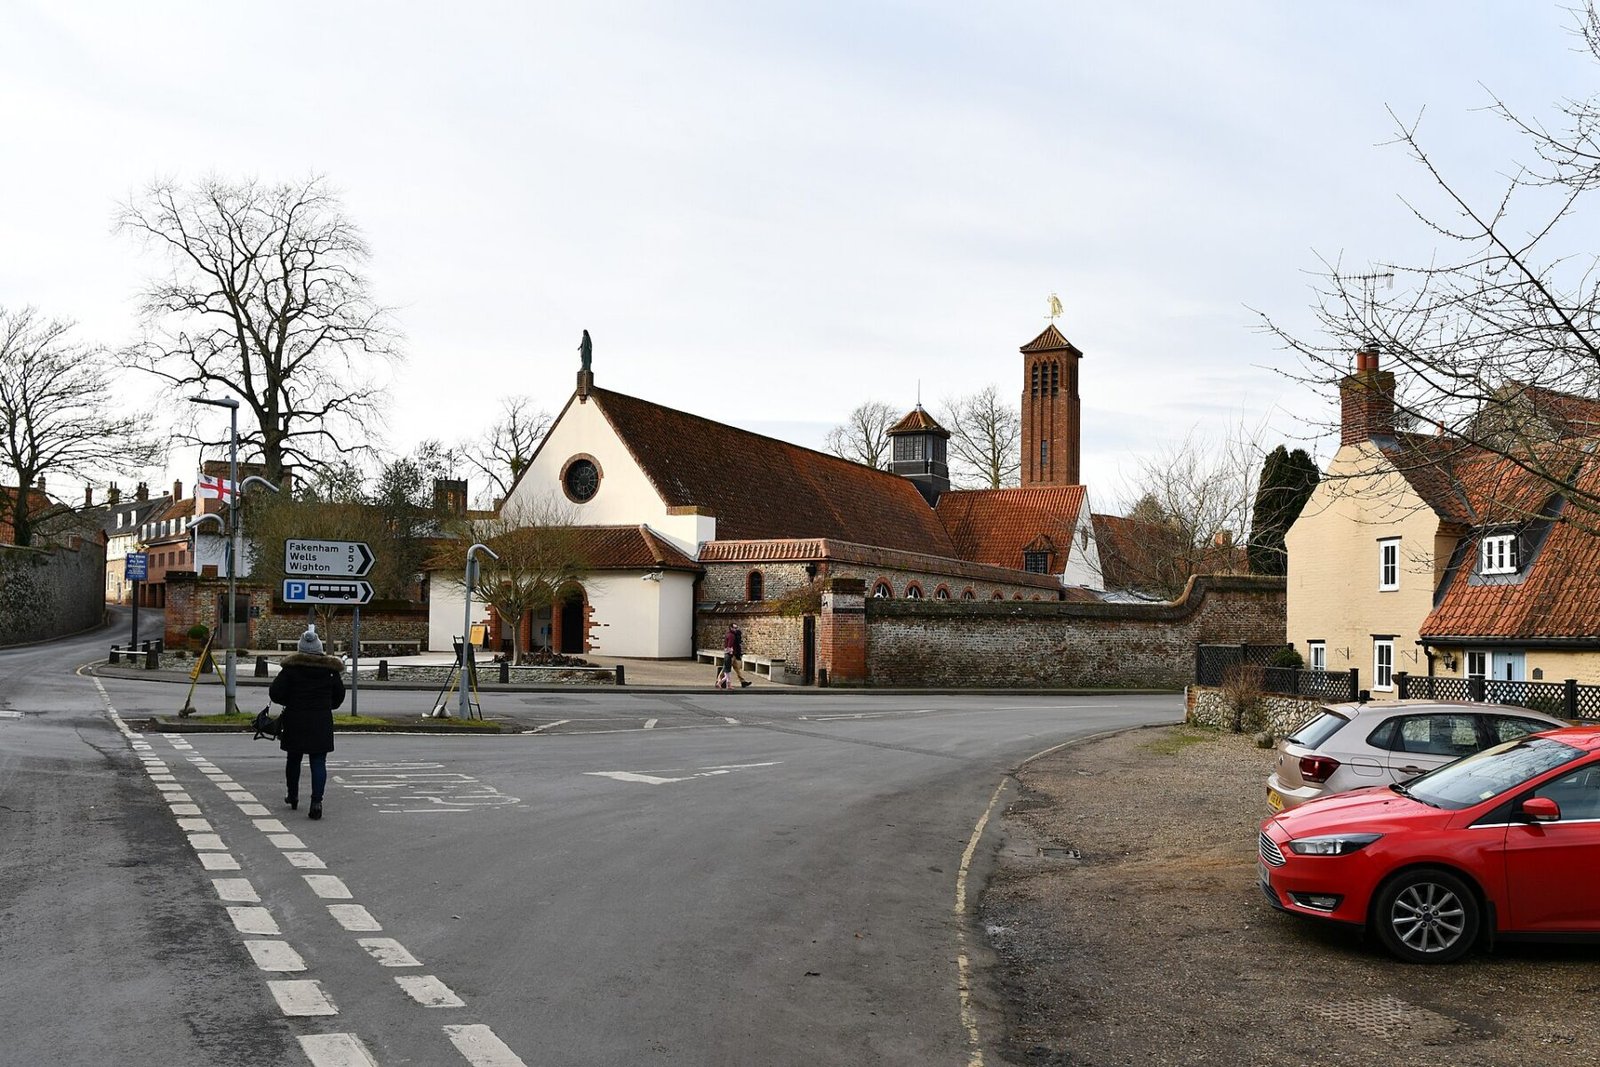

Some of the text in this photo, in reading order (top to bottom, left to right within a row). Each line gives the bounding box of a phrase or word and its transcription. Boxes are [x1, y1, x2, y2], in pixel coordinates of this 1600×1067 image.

[289, 542, 354, 553] Fakenham 5
[289, 552, 317, 561] Wells
[289, 562, 354, 572] Wighton 2
[290, 584, 303, 598] P
